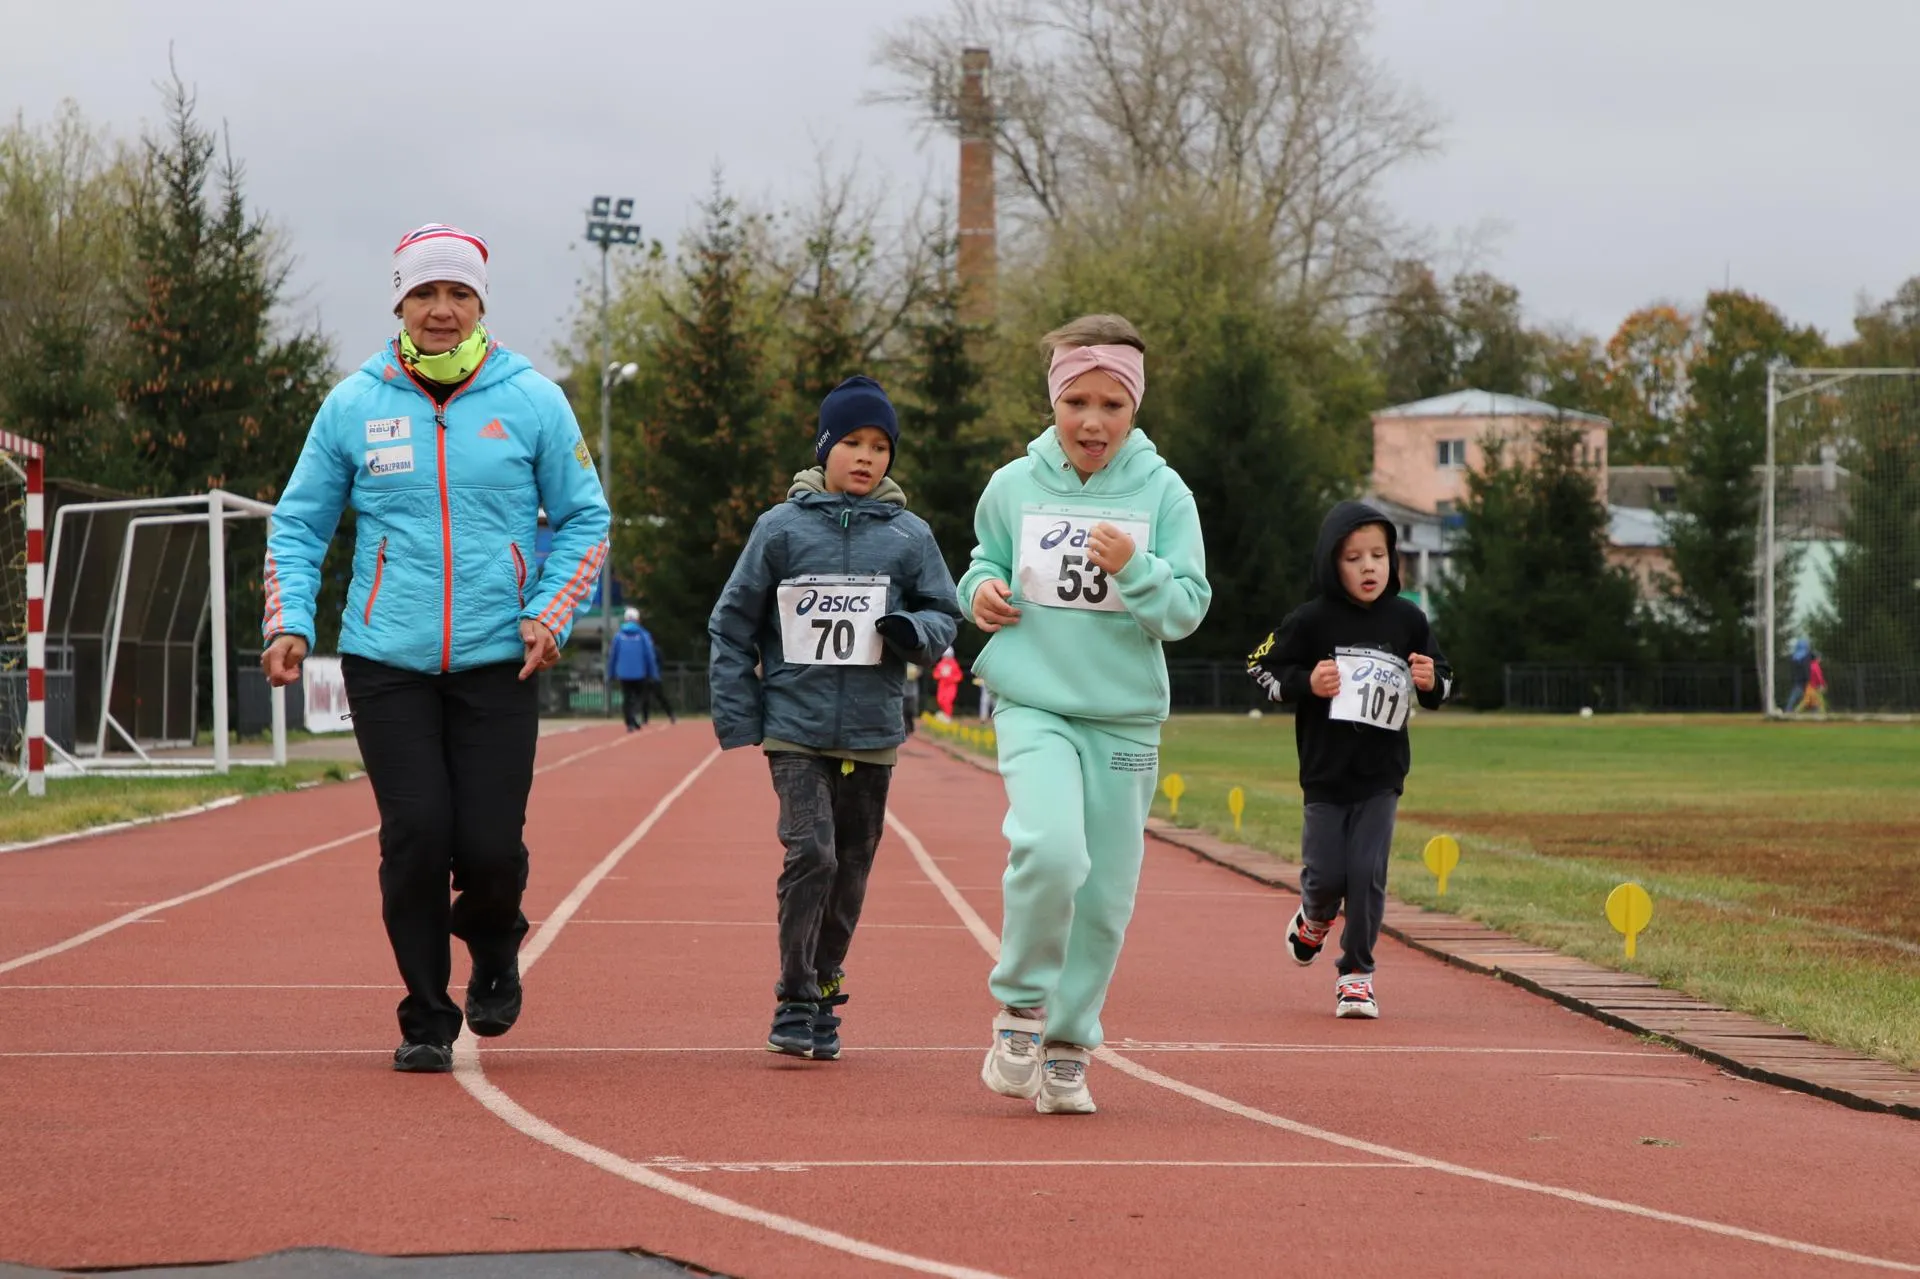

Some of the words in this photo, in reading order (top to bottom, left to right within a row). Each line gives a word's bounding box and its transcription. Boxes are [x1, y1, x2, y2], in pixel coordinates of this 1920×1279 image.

[380, 461, 411, 472] GAZPROM
[1056, 555, 1108, 604] 53
[811, 619, 855, 660] 70
[1357, 683, 1400, 725] 101
